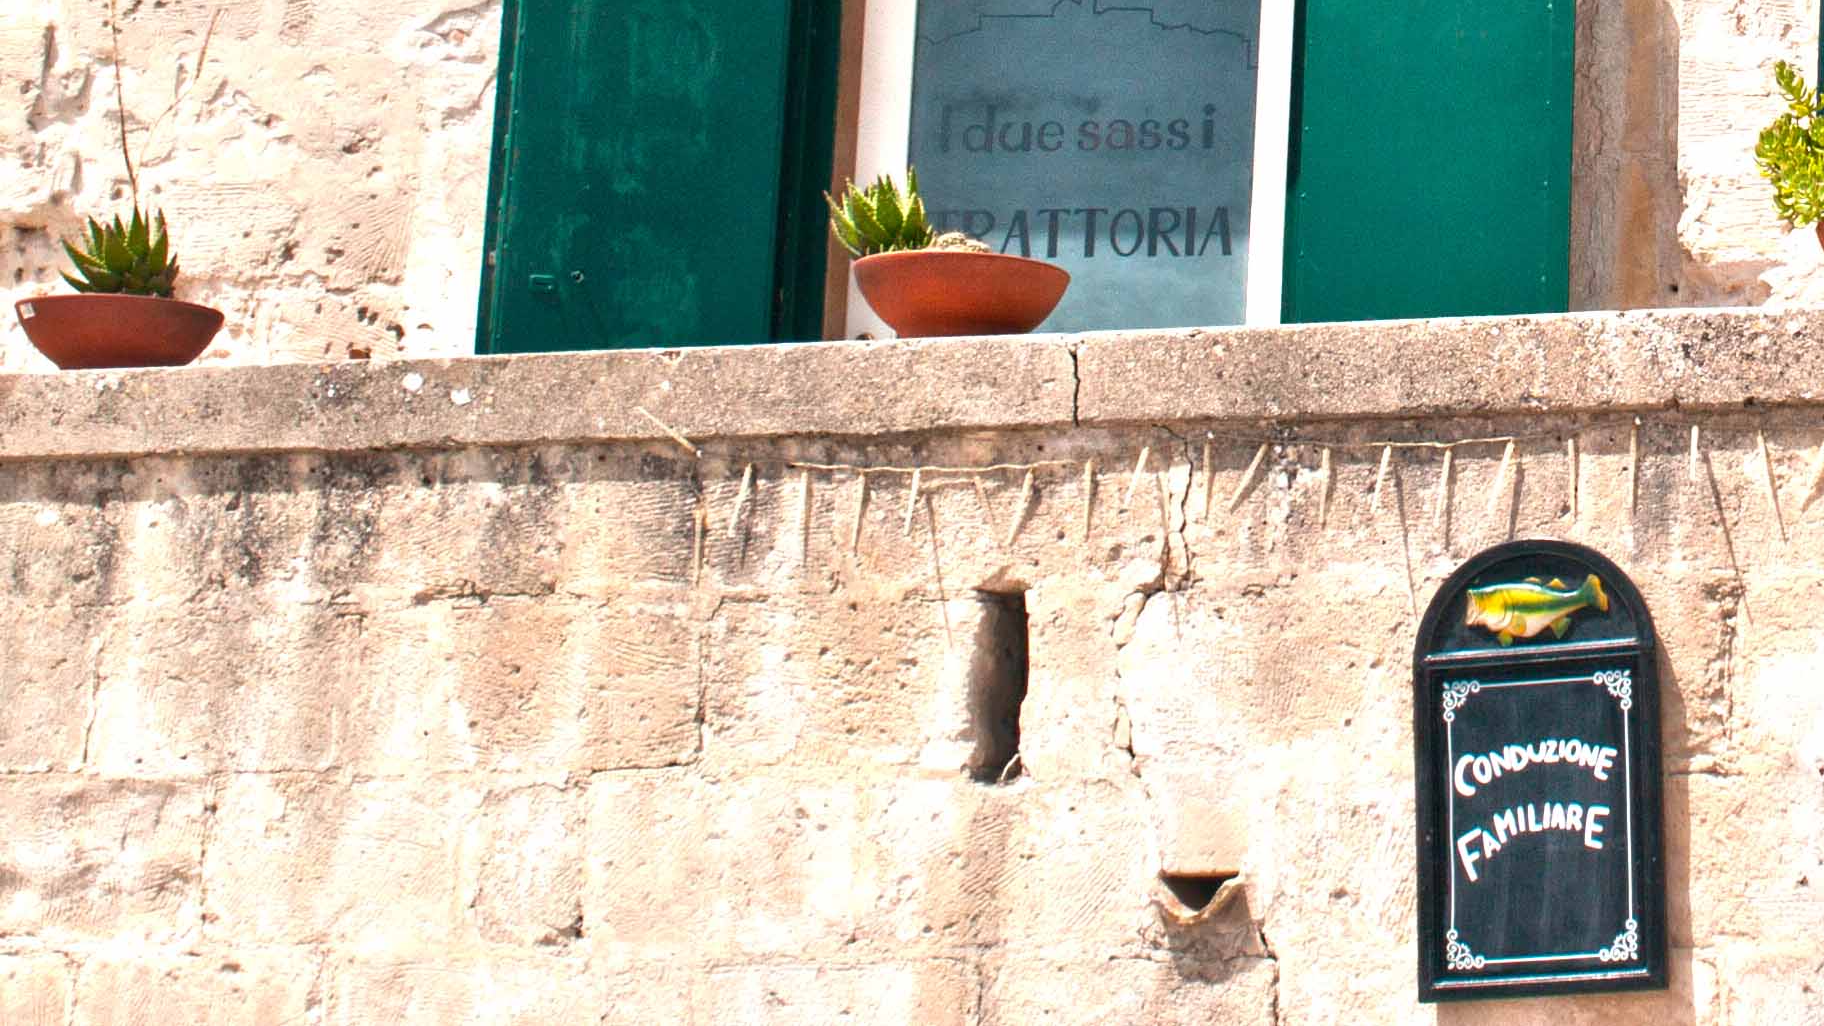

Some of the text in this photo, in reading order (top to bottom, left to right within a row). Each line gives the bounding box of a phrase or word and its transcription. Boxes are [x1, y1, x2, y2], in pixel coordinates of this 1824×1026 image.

[960, 102, 1065, 154] due
[1077, 102, 1218, 152] sassi
[1453, 739, 1618, 797] CONDUZIONE
[1456, 802, 1610, 882] FAMILIARE
